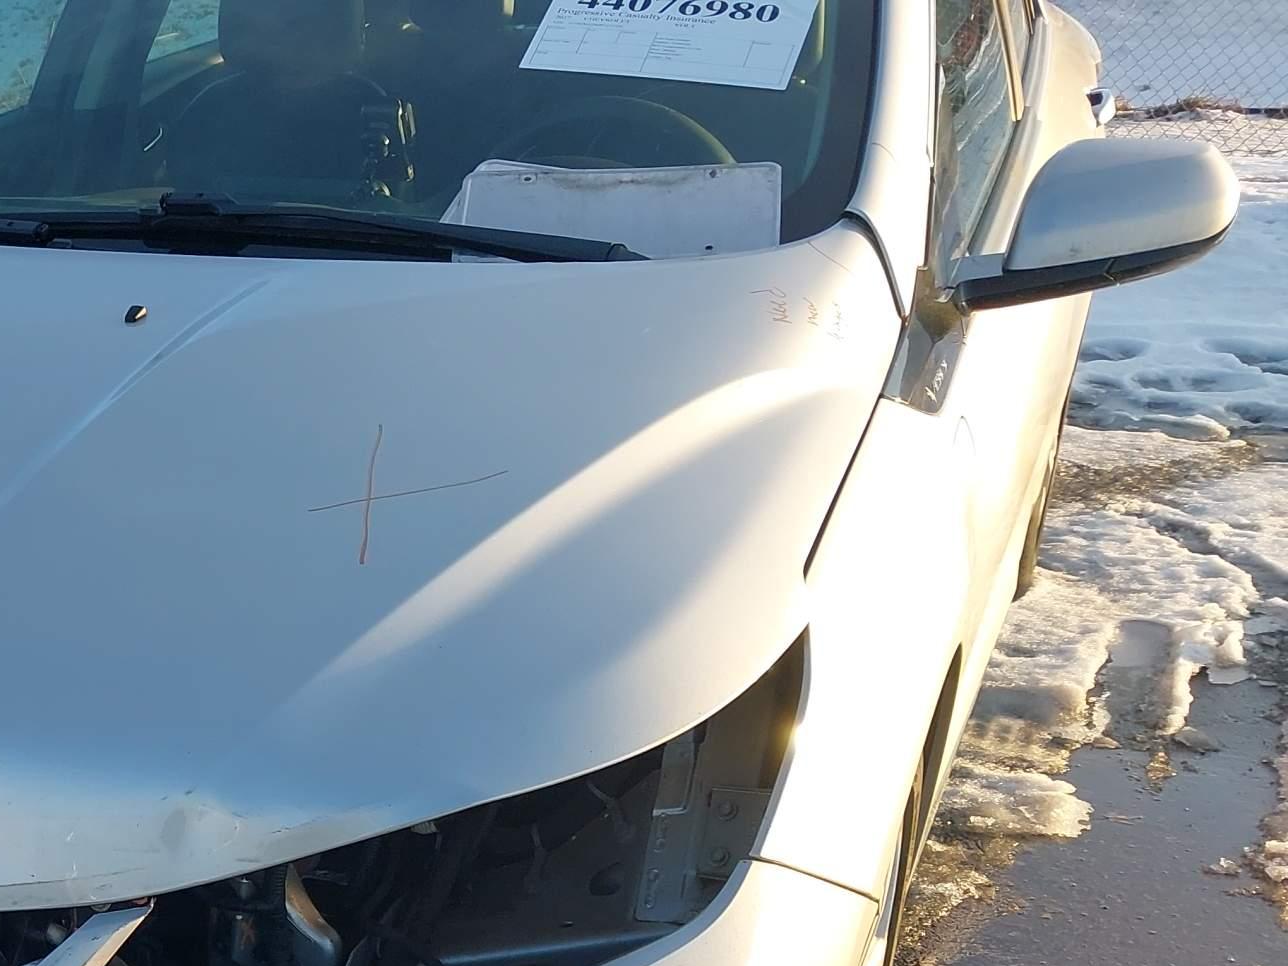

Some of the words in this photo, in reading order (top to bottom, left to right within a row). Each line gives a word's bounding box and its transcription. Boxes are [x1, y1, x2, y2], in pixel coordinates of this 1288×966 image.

[557, 7, 616, 17] Progressive
[618, 11, 661, 20] Casualty
[666, 14, 716, 24] Insurance
